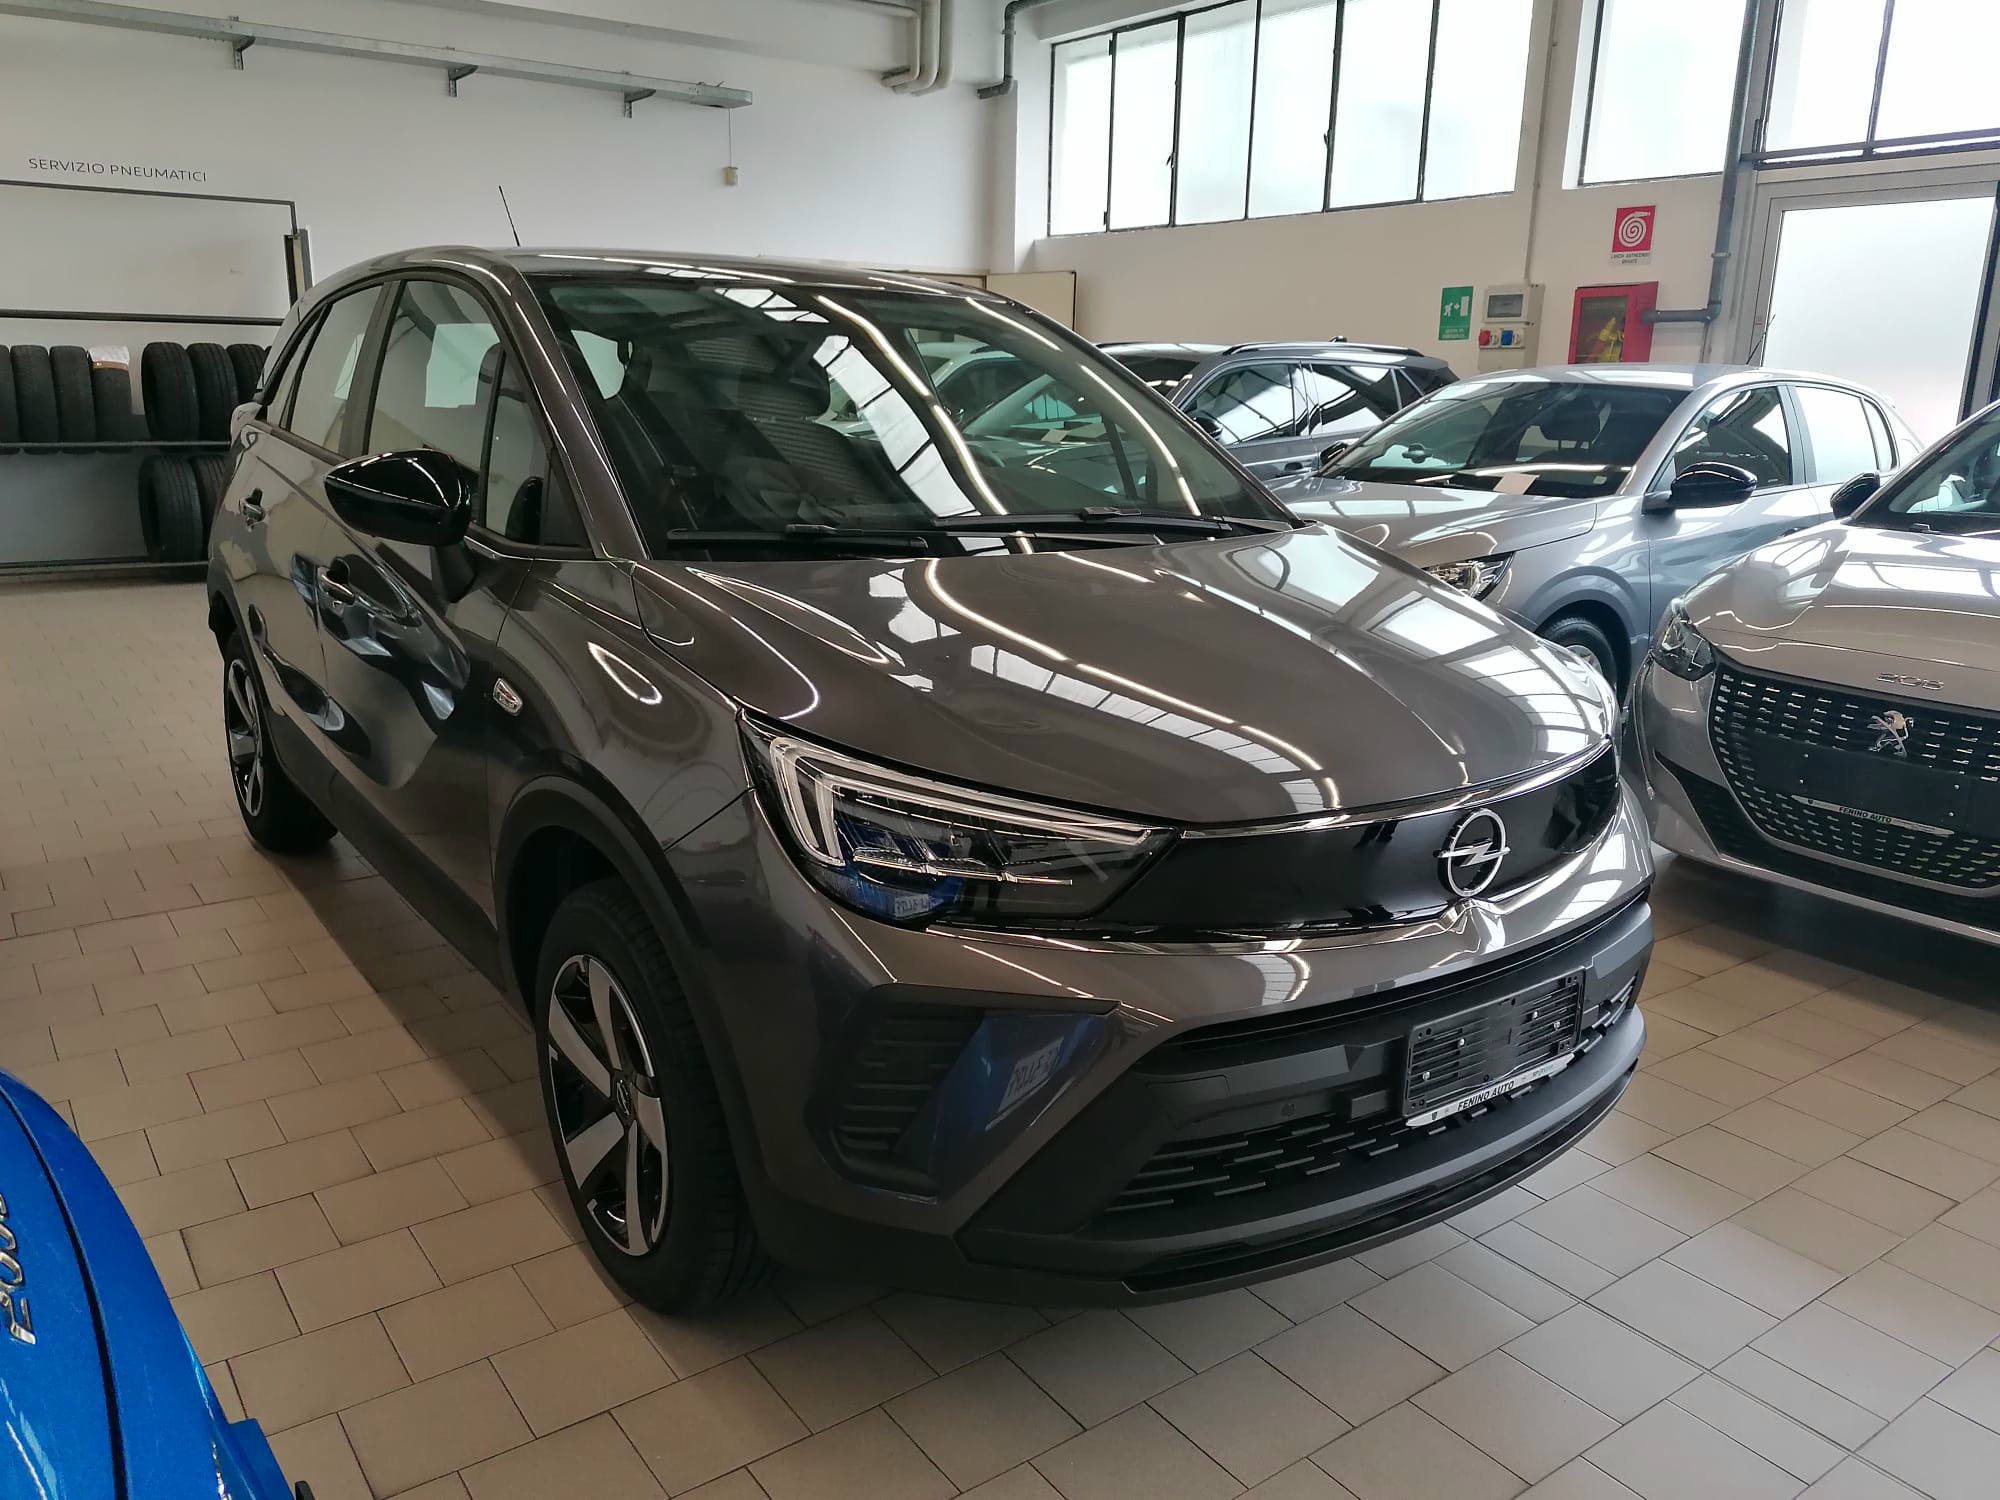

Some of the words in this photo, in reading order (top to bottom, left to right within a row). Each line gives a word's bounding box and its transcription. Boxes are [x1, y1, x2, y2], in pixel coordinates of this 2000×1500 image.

[28, 158, 105, 174] SERVIZIO
[110, 164, 207, 182] PNEUMATICI
[1870, 813, 1893, 823] AUTO
[1457, 1091, 1490, 1111] FENINO
[1491, 1081, 1515, 1097] AUTO
